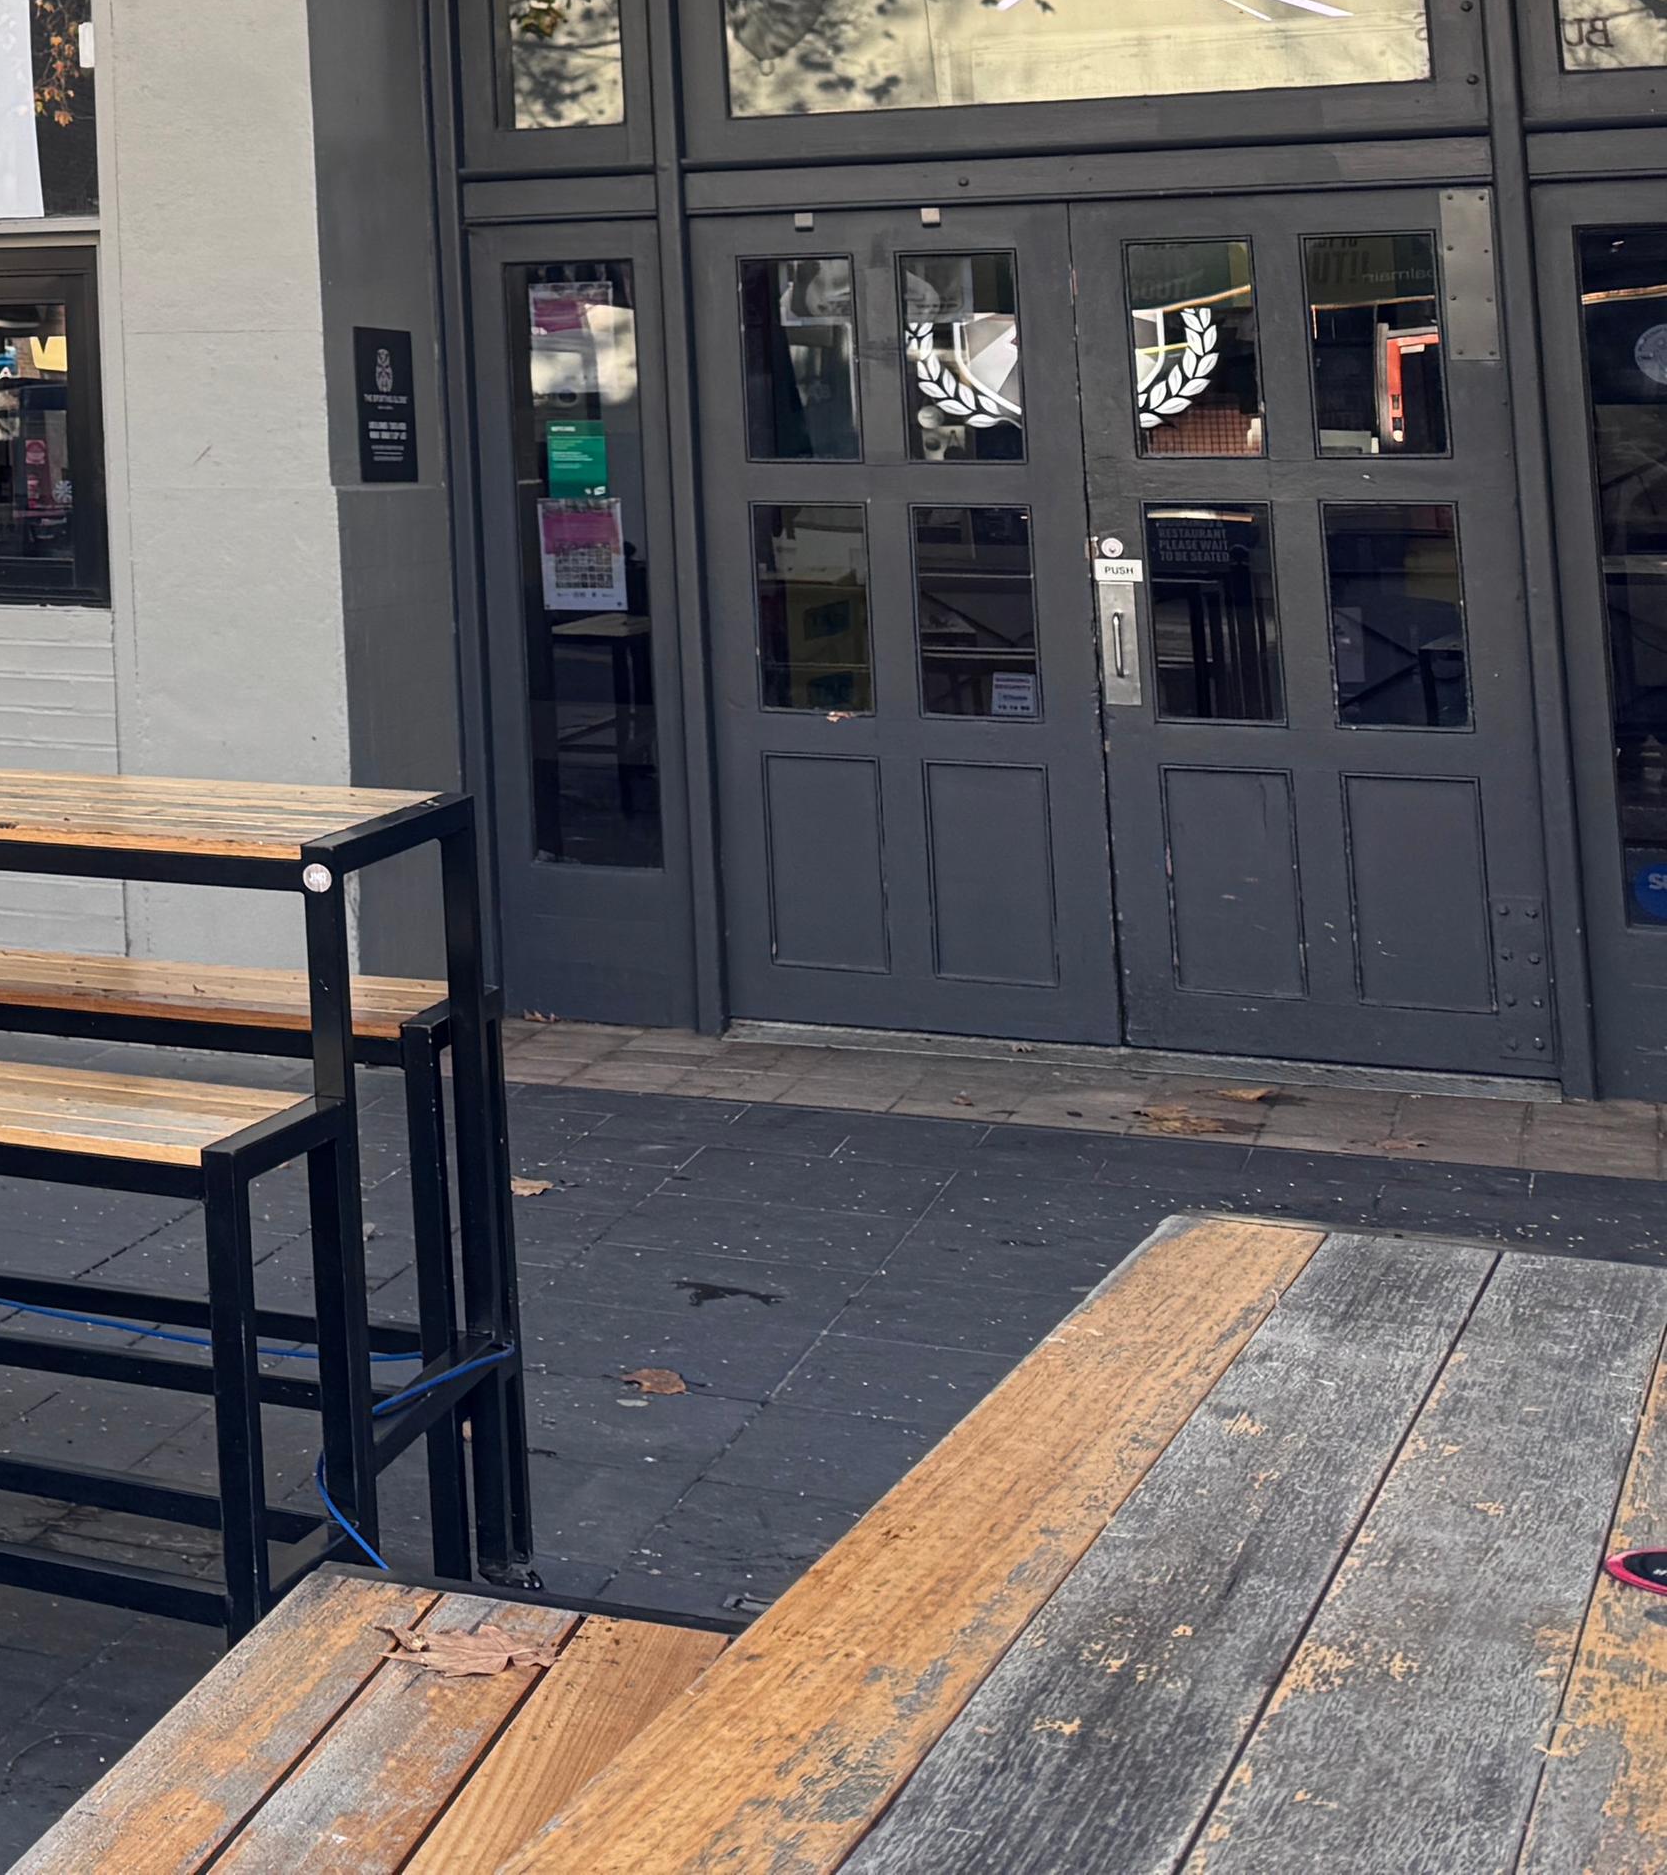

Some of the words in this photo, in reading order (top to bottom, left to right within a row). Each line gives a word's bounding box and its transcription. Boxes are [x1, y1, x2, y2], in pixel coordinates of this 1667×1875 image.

[1157, 528, 1227, 539] RESTAURANT
[1159, 539, 1199, 550] PLEASE
[1199, 540, 1228, 551] WAIT
[1160, 551, 1173, 561] TO
[1190, 551, 1230, 563] SEATED
[1104, 566, 1134, 575] PUSH
